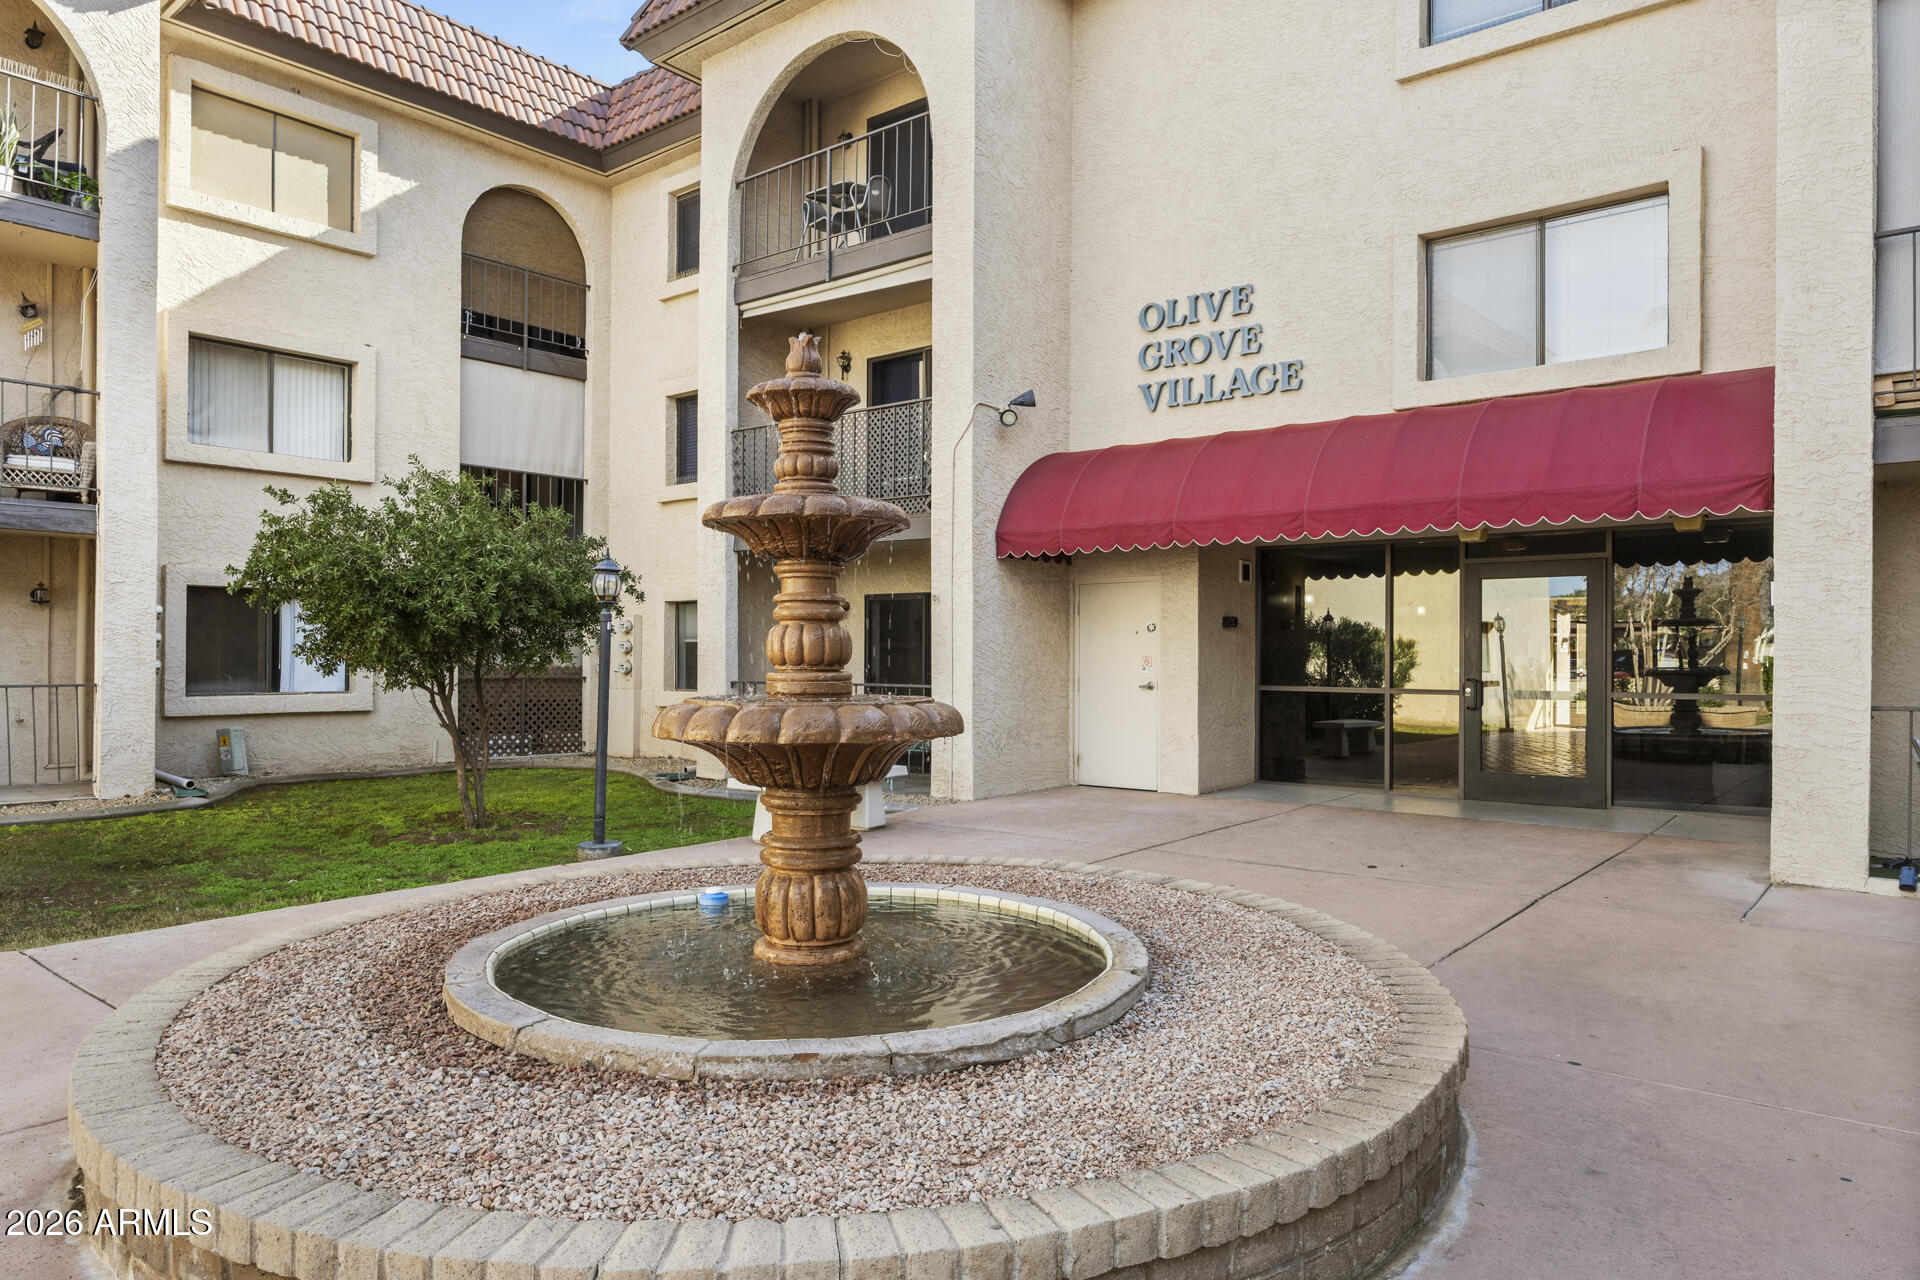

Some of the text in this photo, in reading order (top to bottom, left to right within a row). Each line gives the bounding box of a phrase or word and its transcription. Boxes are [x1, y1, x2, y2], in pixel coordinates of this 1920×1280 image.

[1138, 283, 1255, 333] OLIVE
[1137, 323, 1263, 372] GROVE
[1137, 359, 1304, 413] VILLAGE
